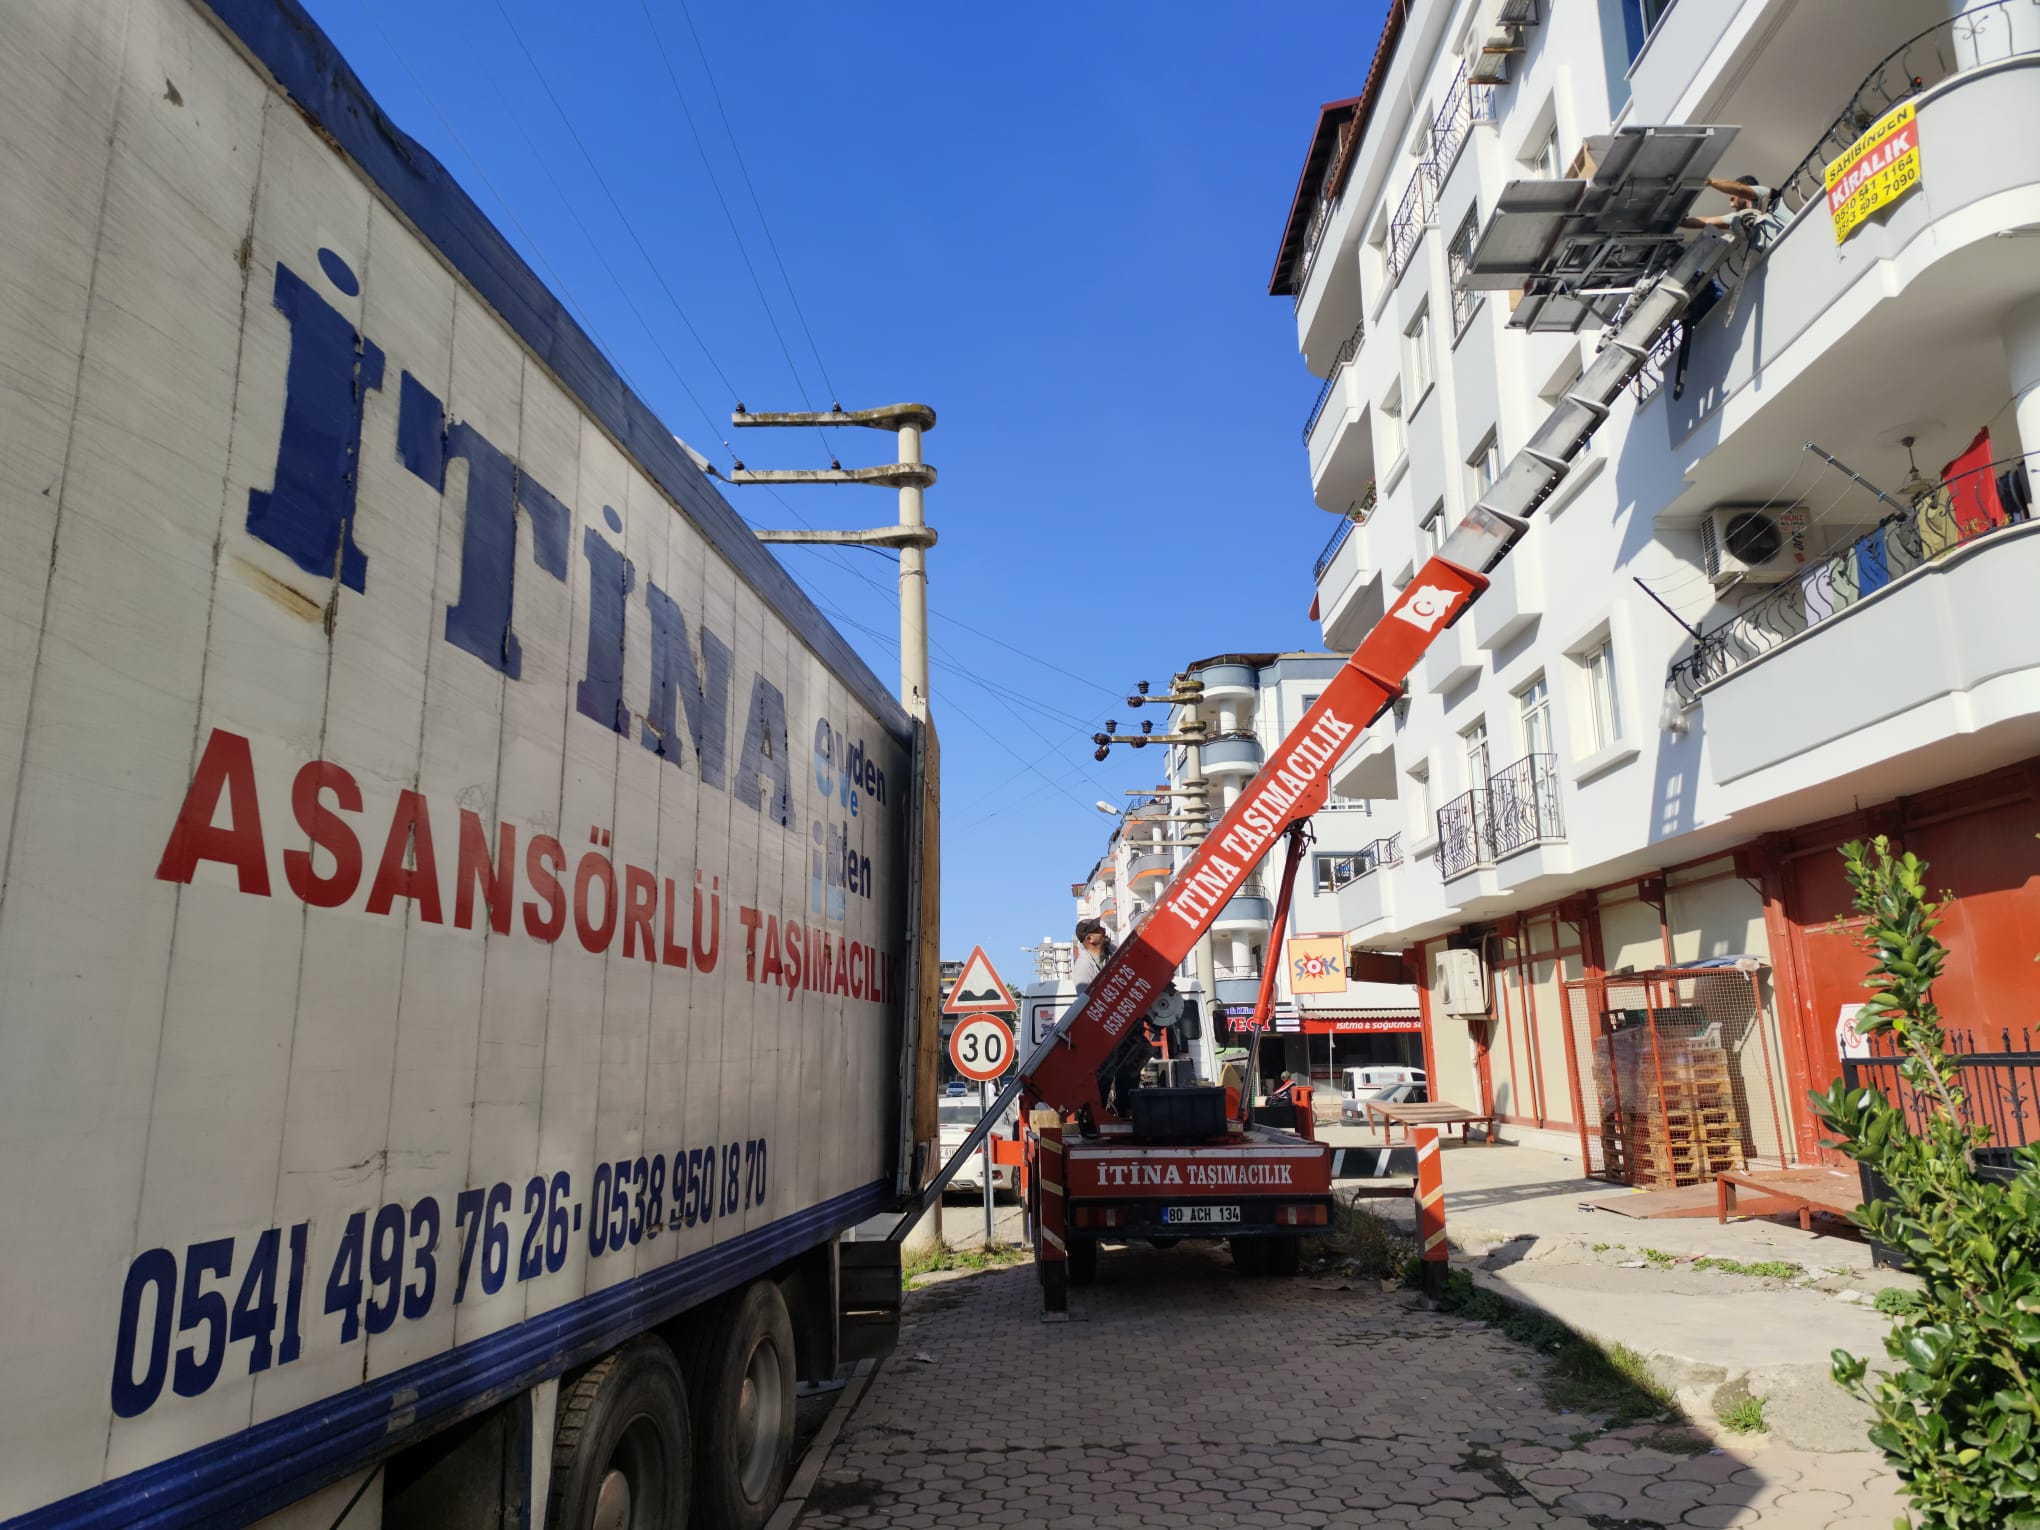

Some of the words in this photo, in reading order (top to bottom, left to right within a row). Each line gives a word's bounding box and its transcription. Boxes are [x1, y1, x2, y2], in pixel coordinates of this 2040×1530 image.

[1831, 131, 1911, 210] KİRALIK
[1858, 179, 1877, 201] 541
[1883, 169, 1916, 197] 7090
[246, 247, 796, 832] İTİNA
[1166, 854, 1241, 930] İTİNA
[1219, 708, 1354, 863] TAŞIMACILIK
[155, 727, 719, 974] ASANSÖRLÜ
[739, 906, 896, 1004] TAŞIMACILIK
[1111, 974, 1128, 990] 76
[1119, 964, 1136, 980] 26
[1101, 984, 1120, 1003] 493
[1128, 987, 1144, 1002] 18
[1134, 978, 1152, 993] 70
[1086, 998, 1109, 1022] 0541
[1117, 997, 1137, 1018] 950
[1103, 1011, 1126, 1036] 0538
[962, 1033, 1001, 1063] 30
[1096, 1162, 1183, 1186] İTİNA
[1187, 1164, 1293, 1189] TAŞIMACILIK
[1169, 1208, 1183, 1222] 80
[1190, 1208, 1211, 1221] ACH
[1219, 1207, 1240, 1221] 134
[110, 1222, 310, 1419] 0541
[324, 1197, 440, 1345] 493
[453, 1182, 513, 1306] 76
[589, 1154, 666, 1258] 0538
[669, 1145, 716, 1233] 950
[718, 1141, 741, 1219] 18
[745, 1137, 768, 1211] 70
